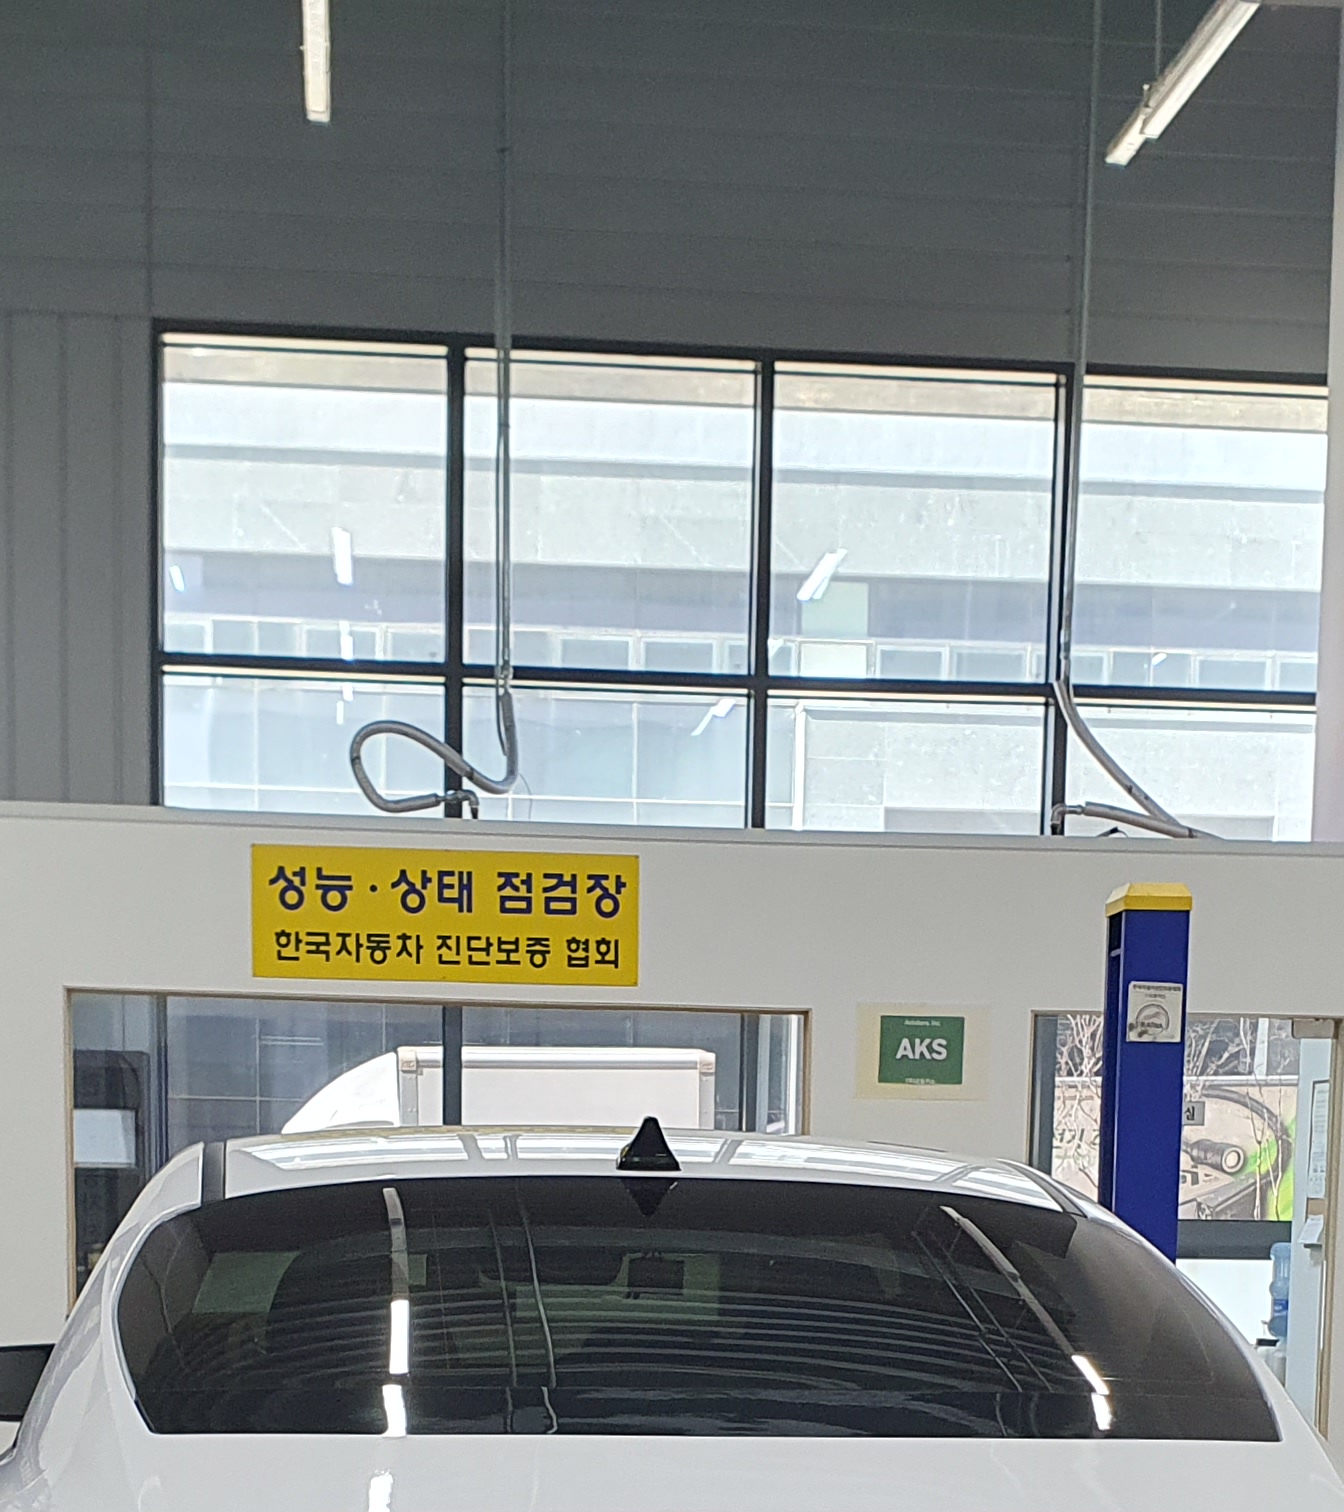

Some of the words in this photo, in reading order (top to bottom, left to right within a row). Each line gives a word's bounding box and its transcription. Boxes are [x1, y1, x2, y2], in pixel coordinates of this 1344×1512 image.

[496, 871, 627, 919] 점검장
[274, 929, 424, 965] 한국자동차
[435, 934, 552, 969] 진단보증
[565, 936, 621, 969] 협회
[895, 1037, 948, 1061] AKS
